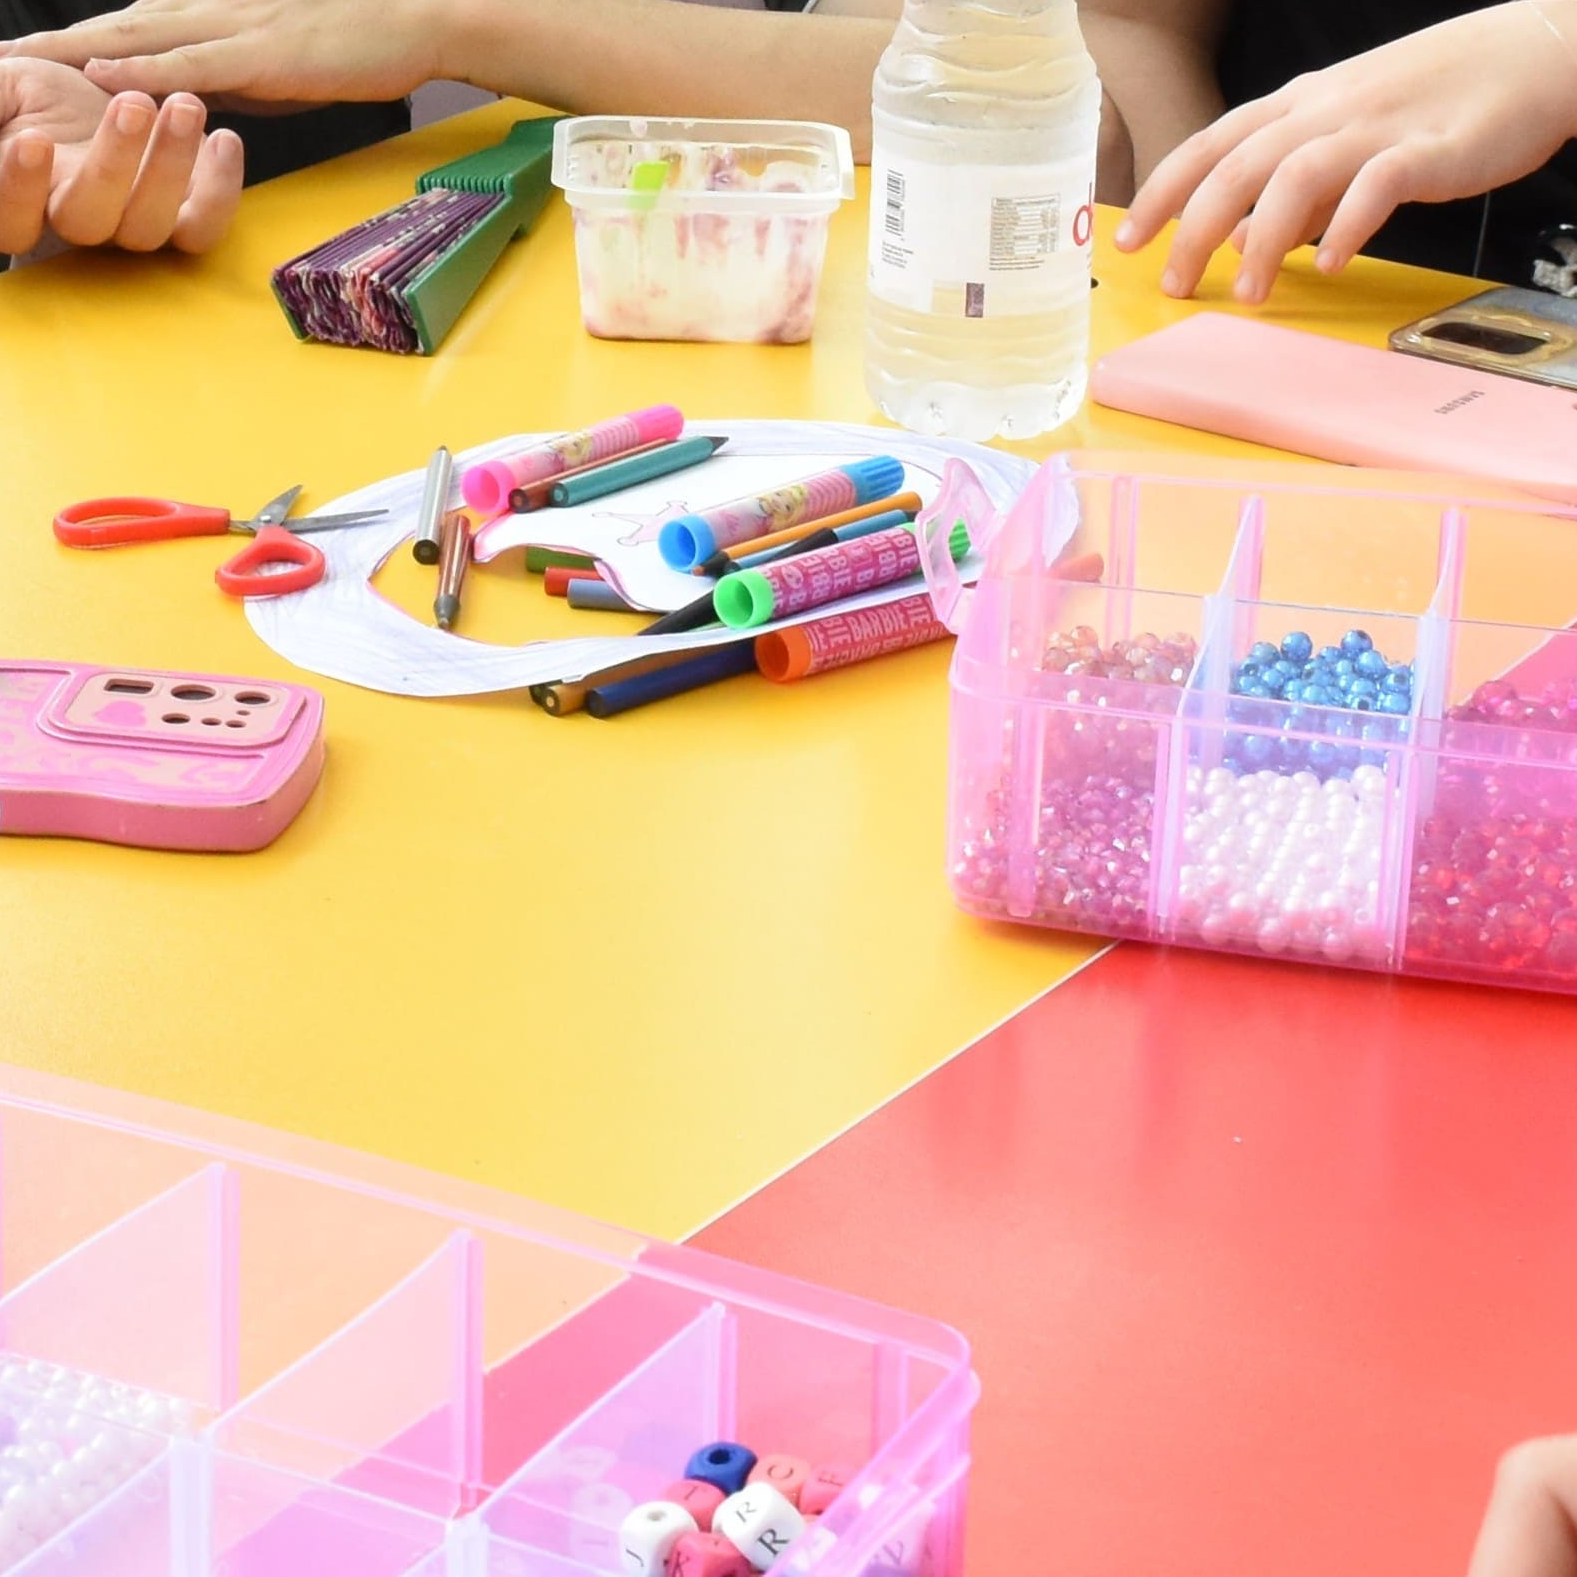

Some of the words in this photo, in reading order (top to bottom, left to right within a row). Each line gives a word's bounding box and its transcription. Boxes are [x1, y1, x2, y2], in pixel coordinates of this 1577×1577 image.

[846, 605, 911, 644] BARBIE
[734, 1500, 758, 1524] R
[757, 1527, 790, 1556] R
